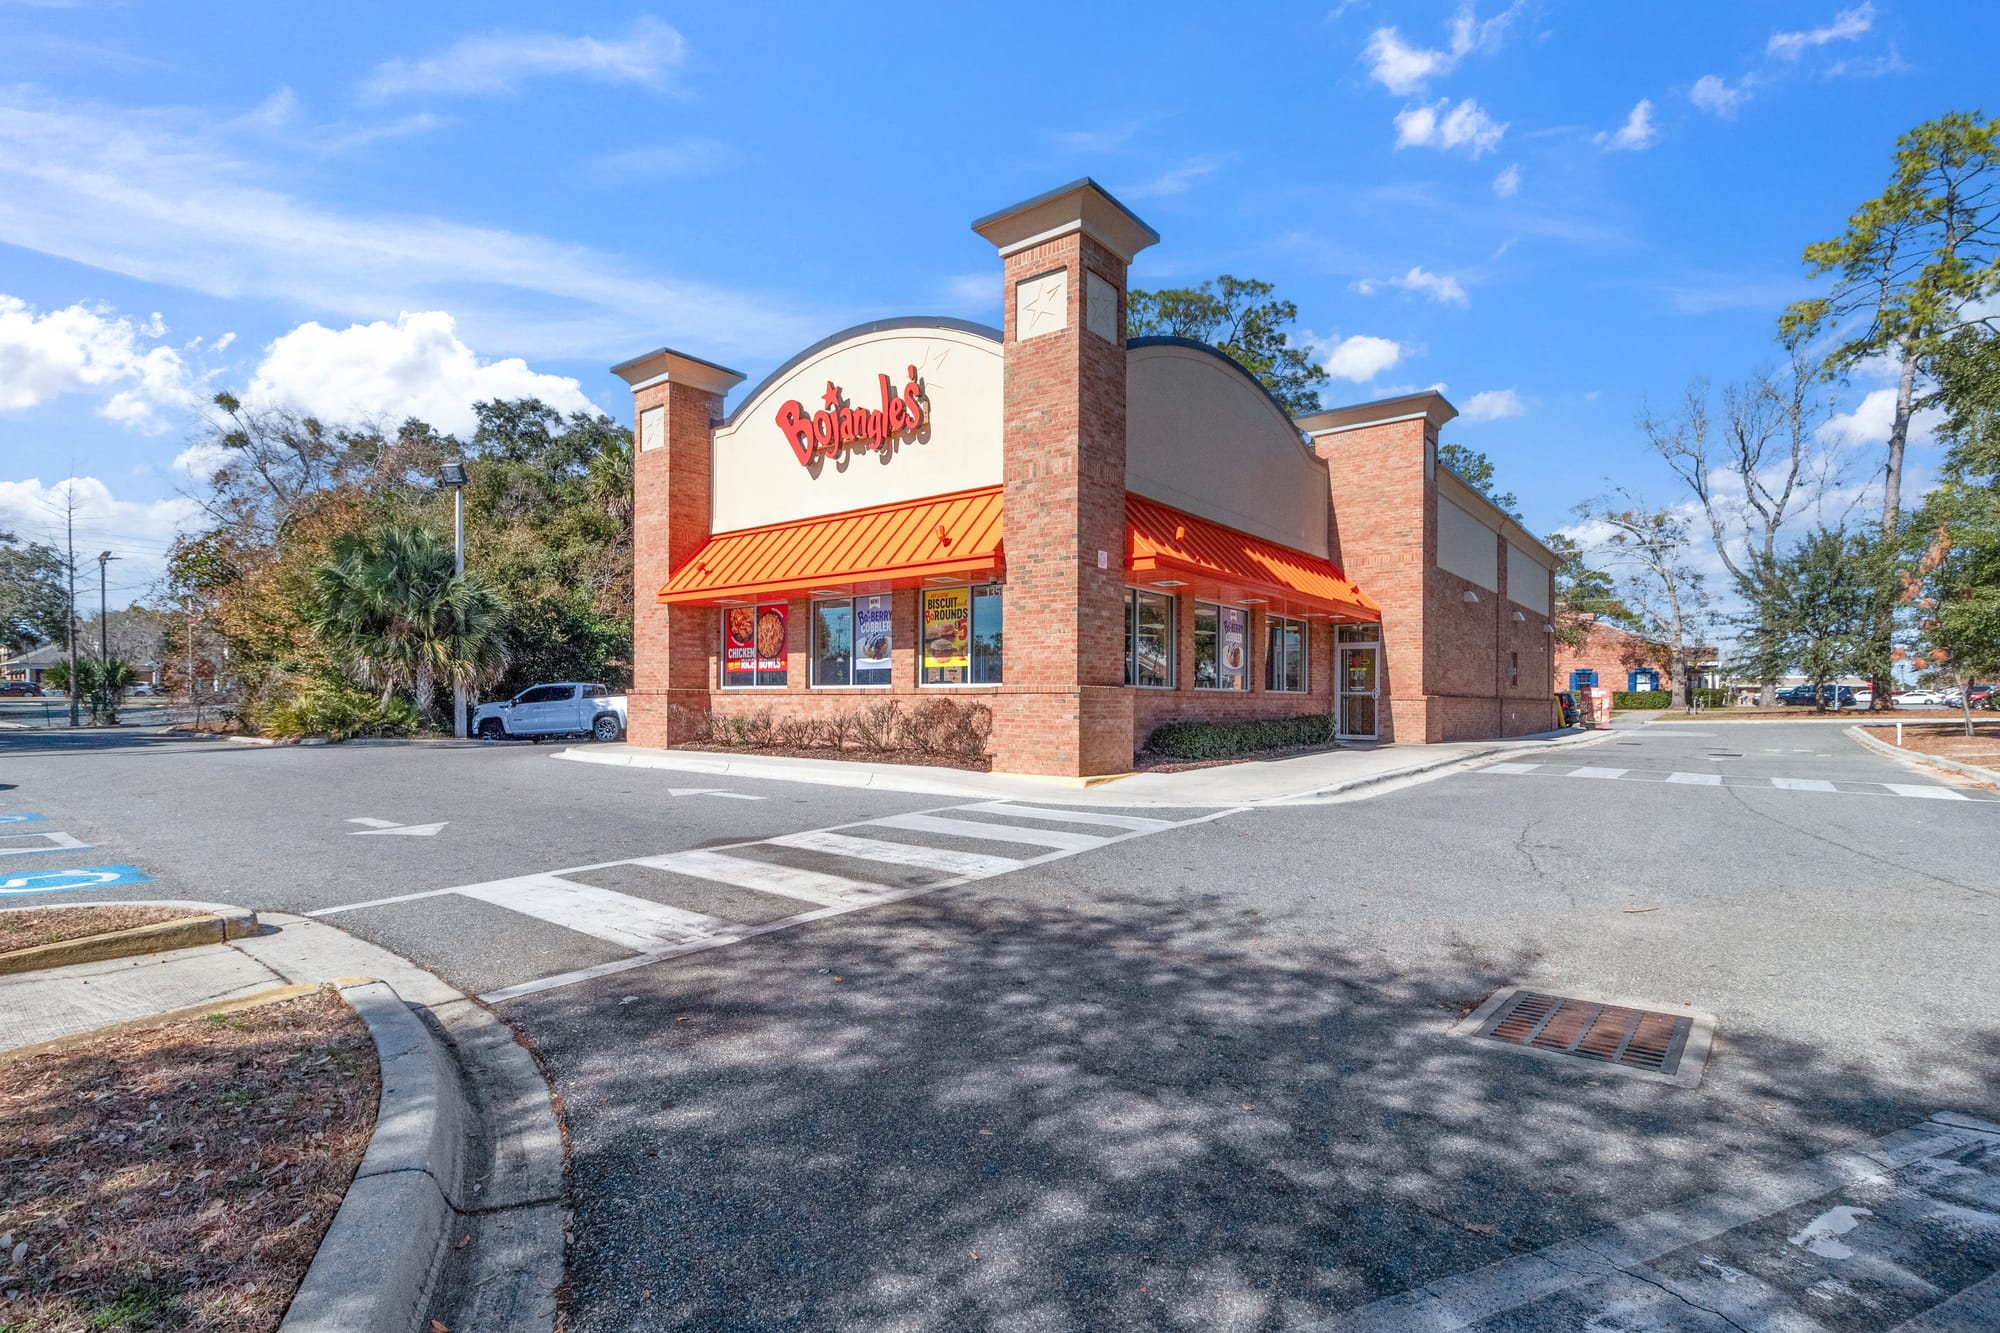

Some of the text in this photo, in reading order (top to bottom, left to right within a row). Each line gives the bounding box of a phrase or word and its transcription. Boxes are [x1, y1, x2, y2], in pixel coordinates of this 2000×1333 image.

[927, 597, 958, 609] BISCUIT
[861, 621, 891, 633] COBBLER
[728, 647, 755, 659] CHICKEN
[759, 657, 781, 669] BOWLS
